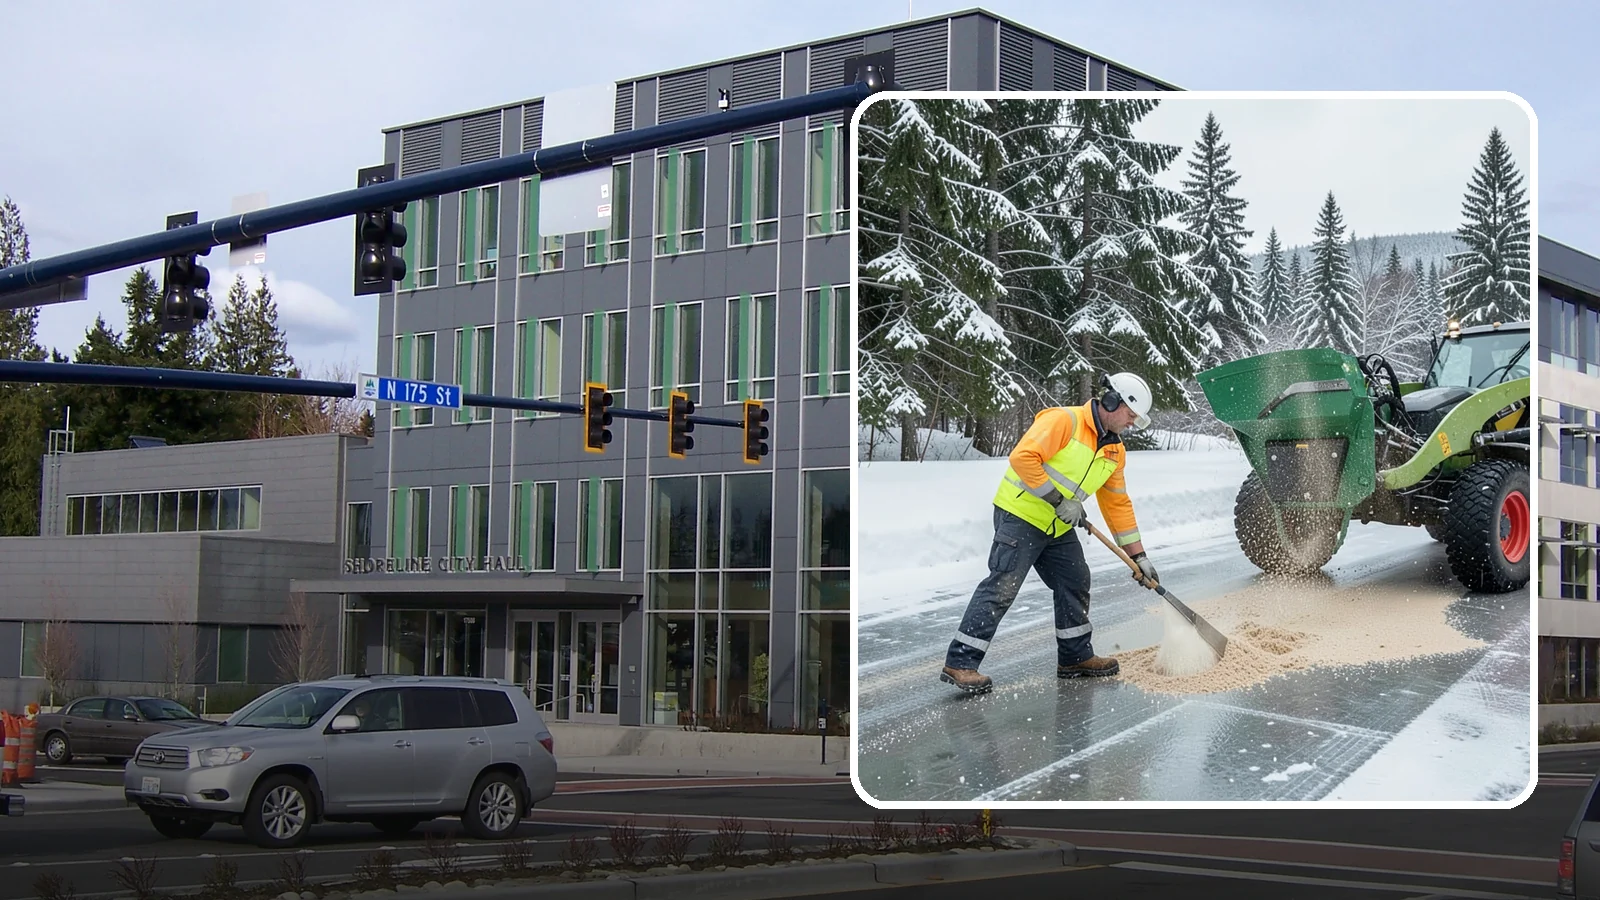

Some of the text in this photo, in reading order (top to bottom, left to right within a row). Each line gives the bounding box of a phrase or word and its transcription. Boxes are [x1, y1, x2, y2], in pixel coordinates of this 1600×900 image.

[387, 381, 451, 406] N 175 St
[344, 556, 525, 574] SHORELINE CITY HALL
